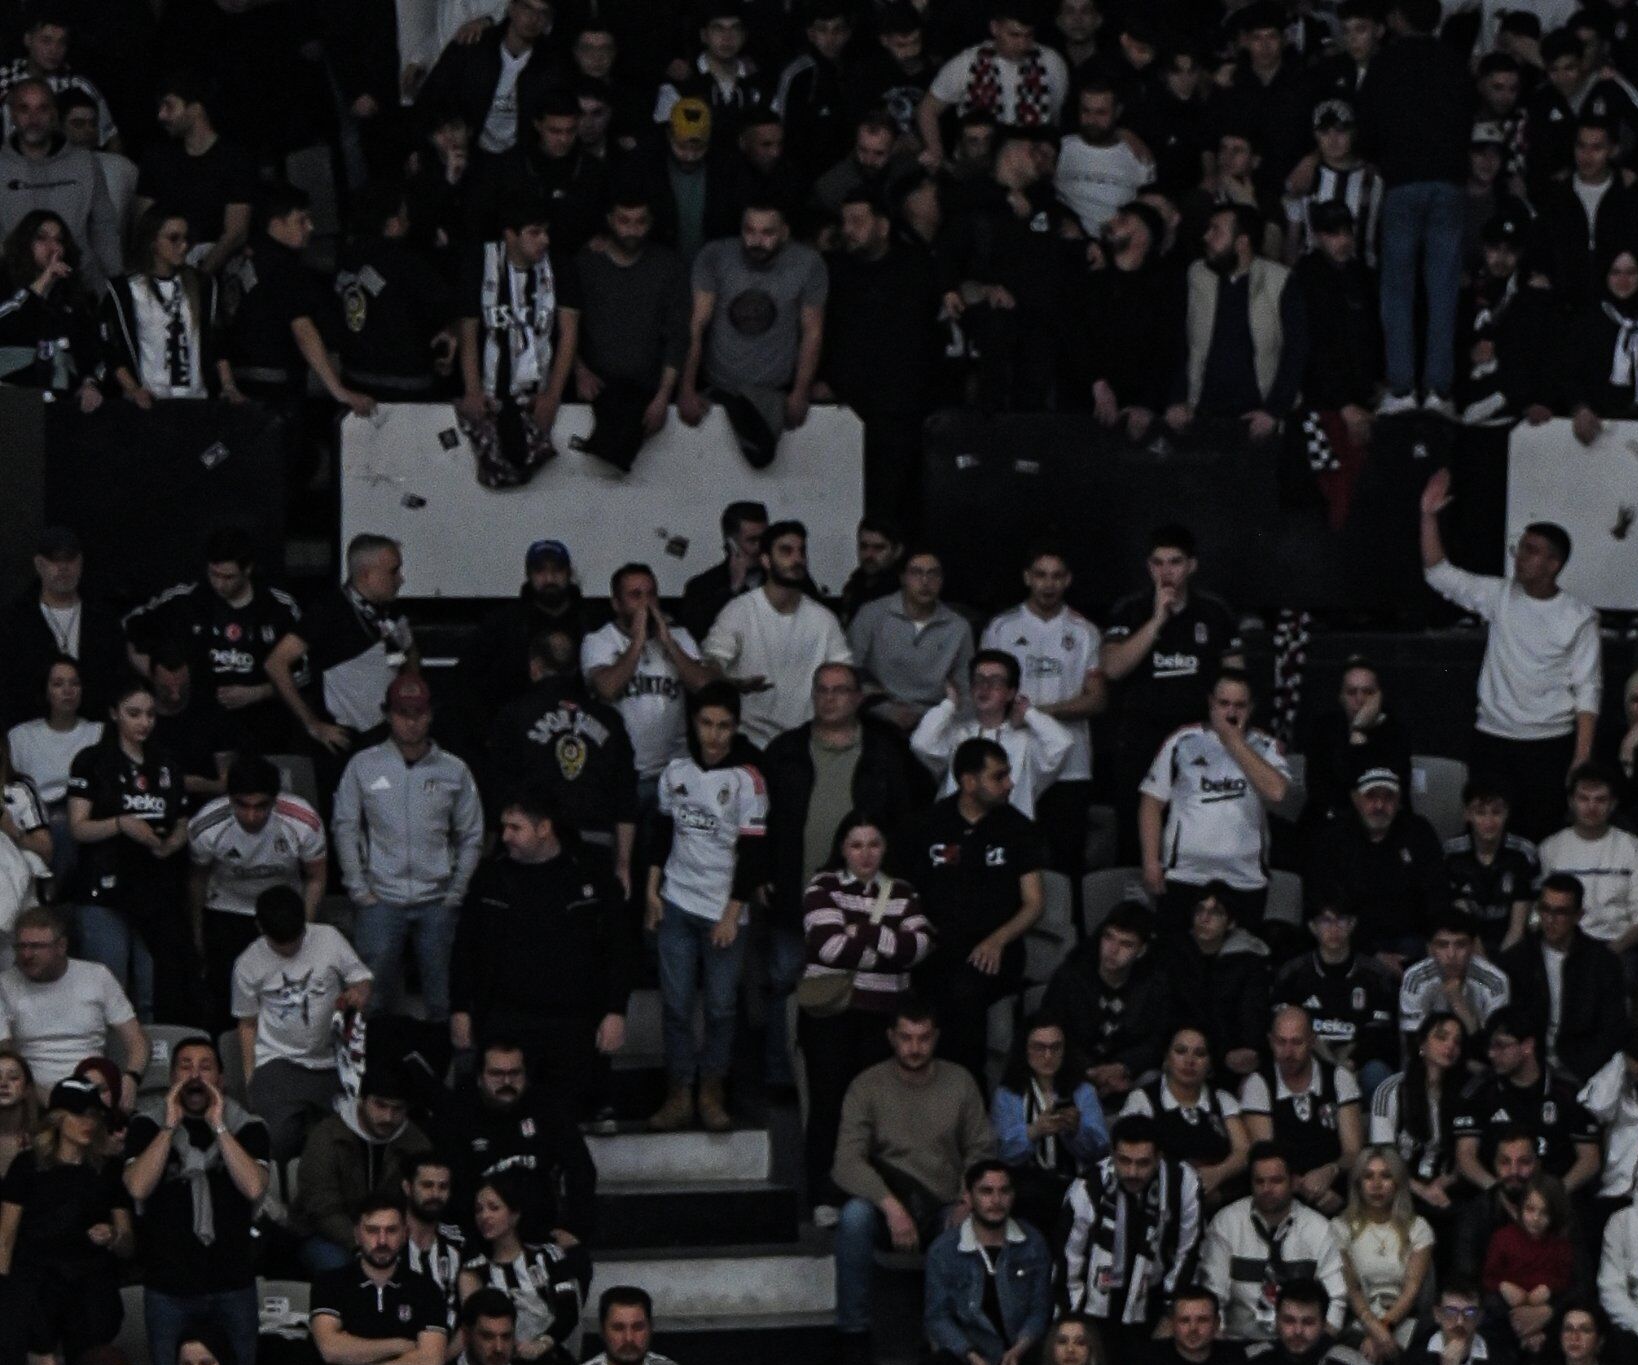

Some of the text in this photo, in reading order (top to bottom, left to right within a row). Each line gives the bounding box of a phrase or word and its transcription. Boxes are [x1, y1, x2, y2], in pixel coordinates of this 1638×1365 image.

[1153, 653, 1199, 669] beko
[1201, 777, 1247, 793] beko
[1312, 1019, 1357, 1034] beko
